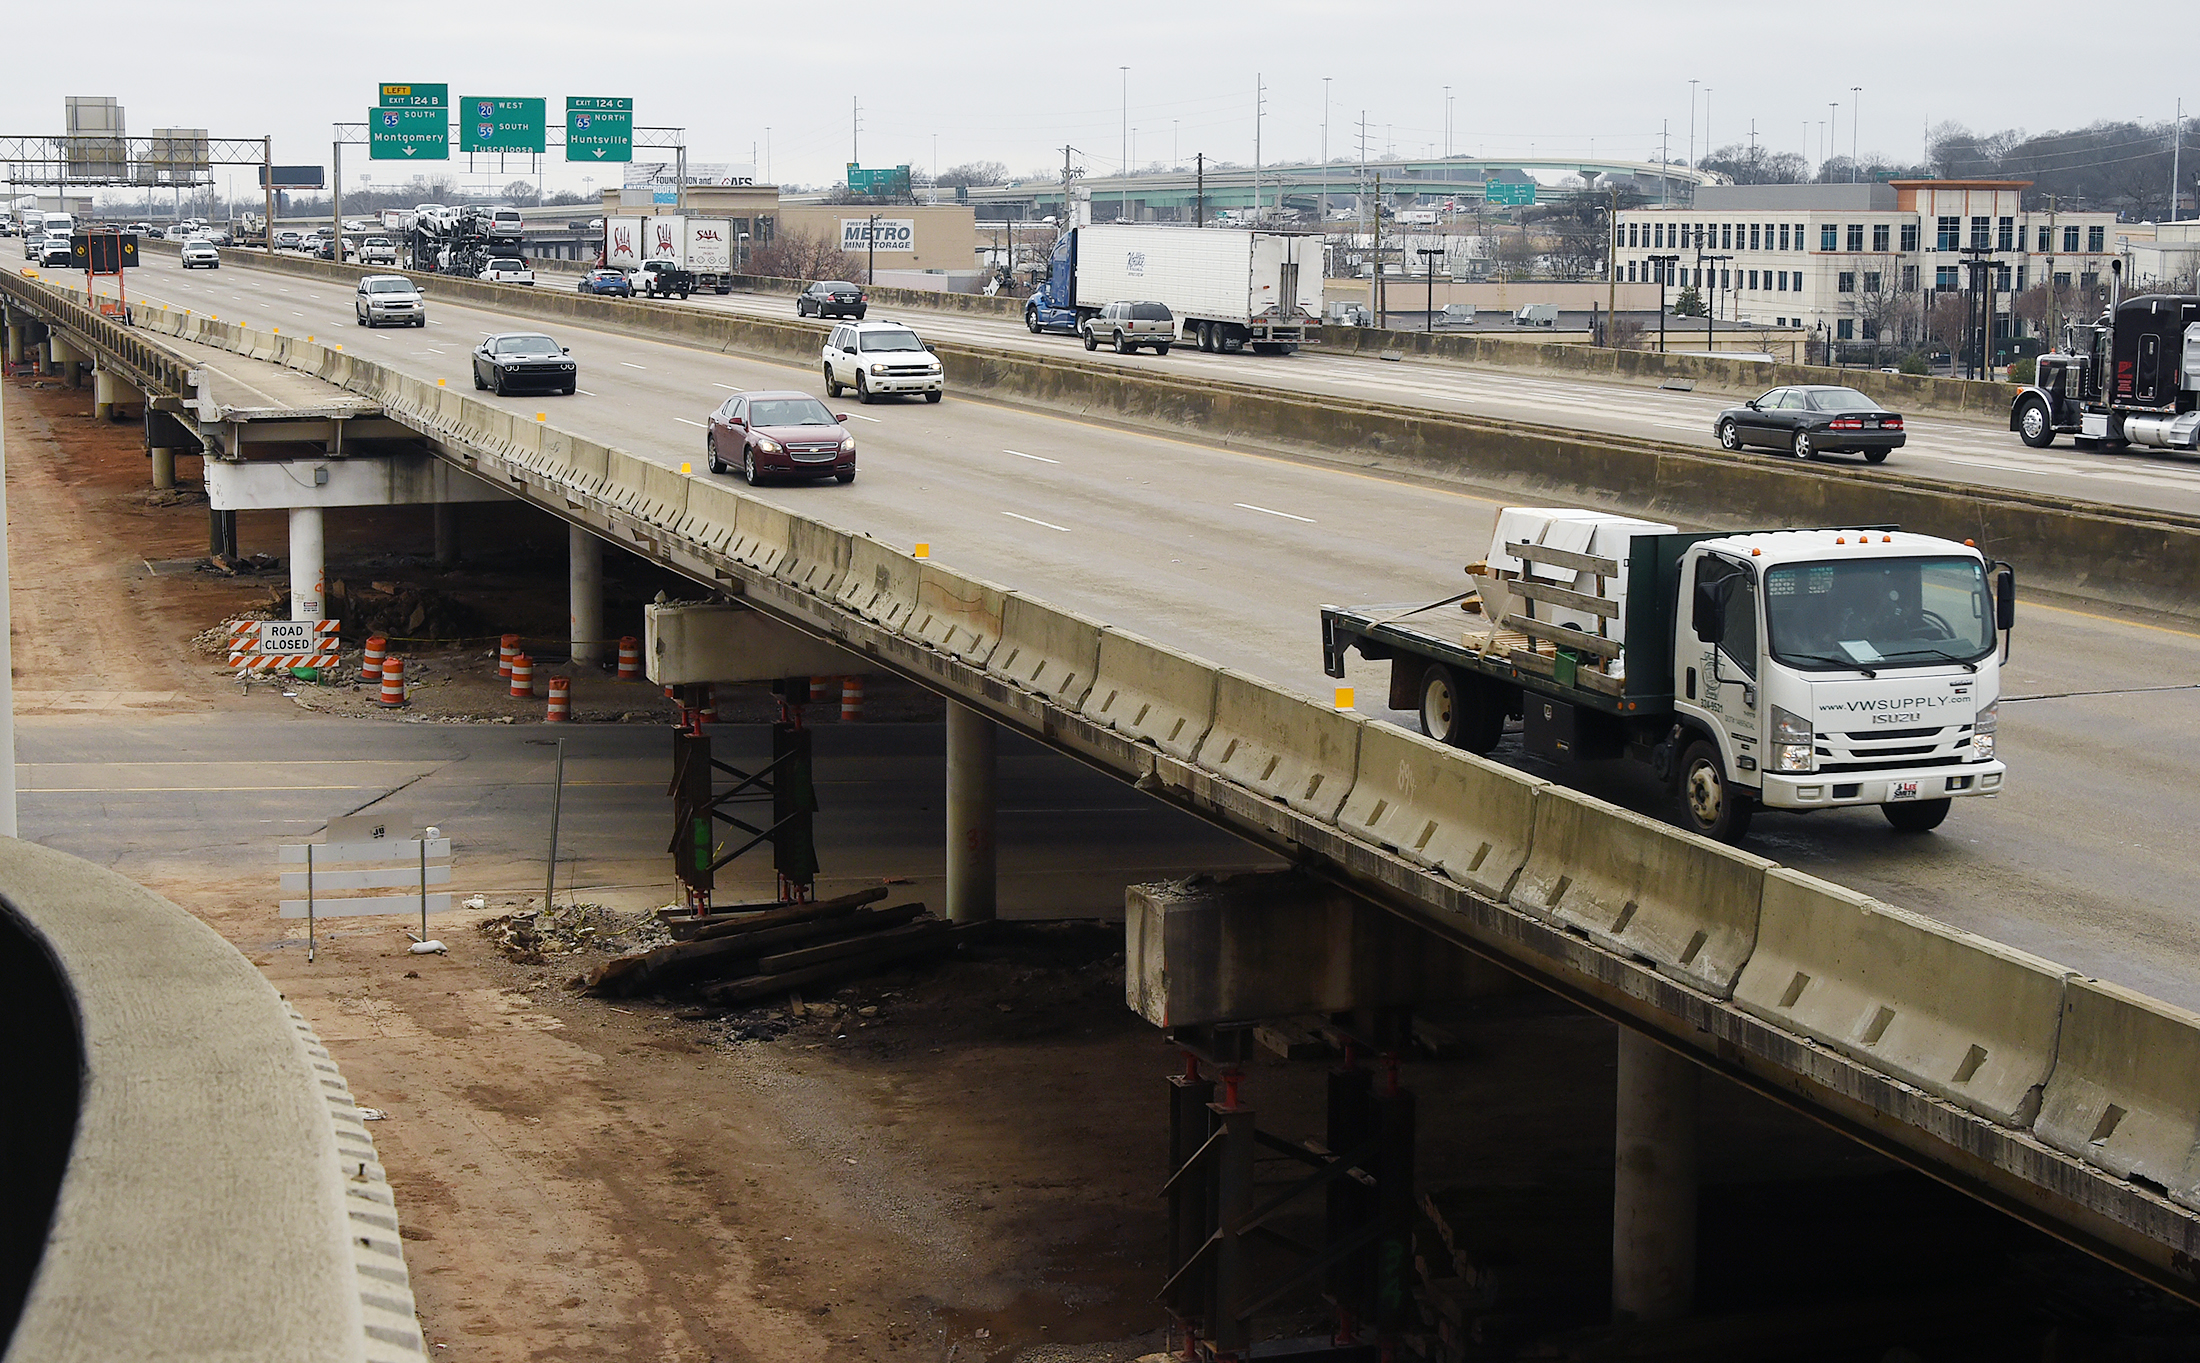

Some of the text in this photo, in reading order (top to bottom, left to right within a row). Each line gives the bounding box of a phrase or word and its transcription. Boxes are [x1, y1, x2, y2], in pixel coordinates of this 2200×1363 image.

[410, 96, 428, 105] 124
[431, 96, 439, 105] B
[596, 99, 613, 108] 124
[617, 99, 624, 108] C
[480, 106, 493, 116] 20
[384, 115, 399, 125] 65
[577, 118, 590, 128] 65
[480, 127, 494, 137] 59
[374, 133, 444, 144] Montgomery
[570, 135, 628, 144] Huntsville
[472, 144, 534, 153] Tuscaloosa
[656, 176, 712, 185] FOUNDAION and
[696, 229, 723, 241] SAIA
[844, 227, 911, 240] METRO
[844, 241, 865, 249] MINI
[271, 626, 304, 636] ROAD
[265, 639, 309, 650] CLOSED
[1818, 695, 1971, 712] www.VWSUPPLY.com
[1872, 711, 1920, 724] ISUZU
